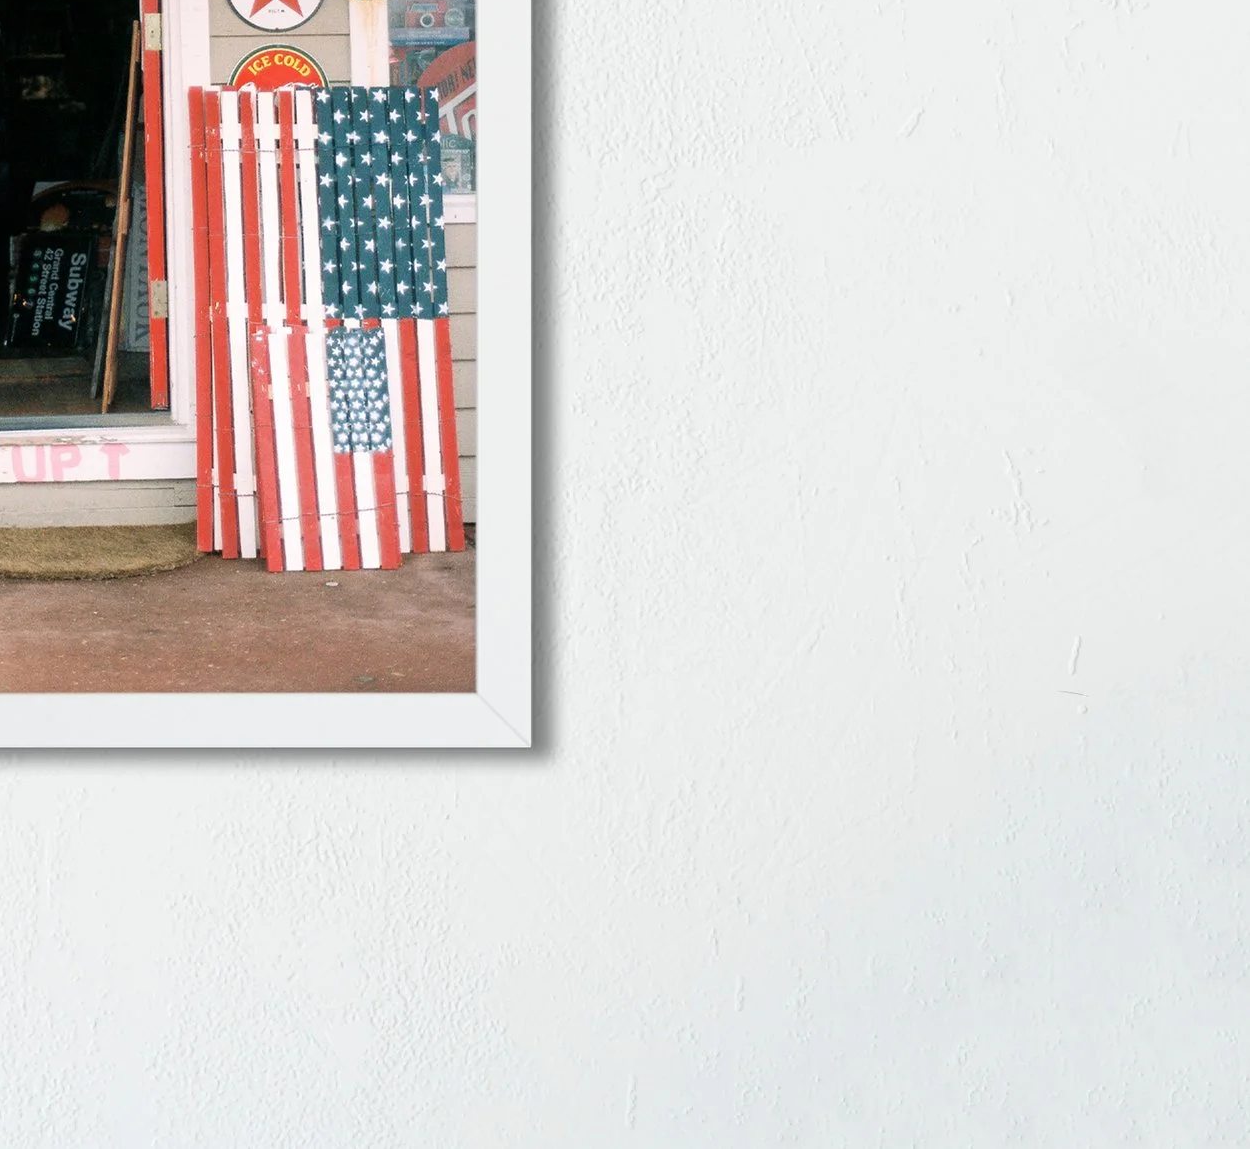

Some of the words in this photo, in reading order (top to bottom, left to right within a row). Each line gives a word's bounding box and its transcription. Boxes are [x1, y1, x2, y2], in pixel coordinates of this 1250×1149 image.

[247, 56, 272, 76] ICE
[273, 53, 311, 77] COLD
[43, 247, 54, 261] 42
[50, 248, 64, 280] Grand
[37, 263, 53, 296] Street
[57, 252, 87, 332] Subway
[31, 297, 47, 337] Station
[43, 282, 59, 321] Central
[12, 442, 83, 483] UP
